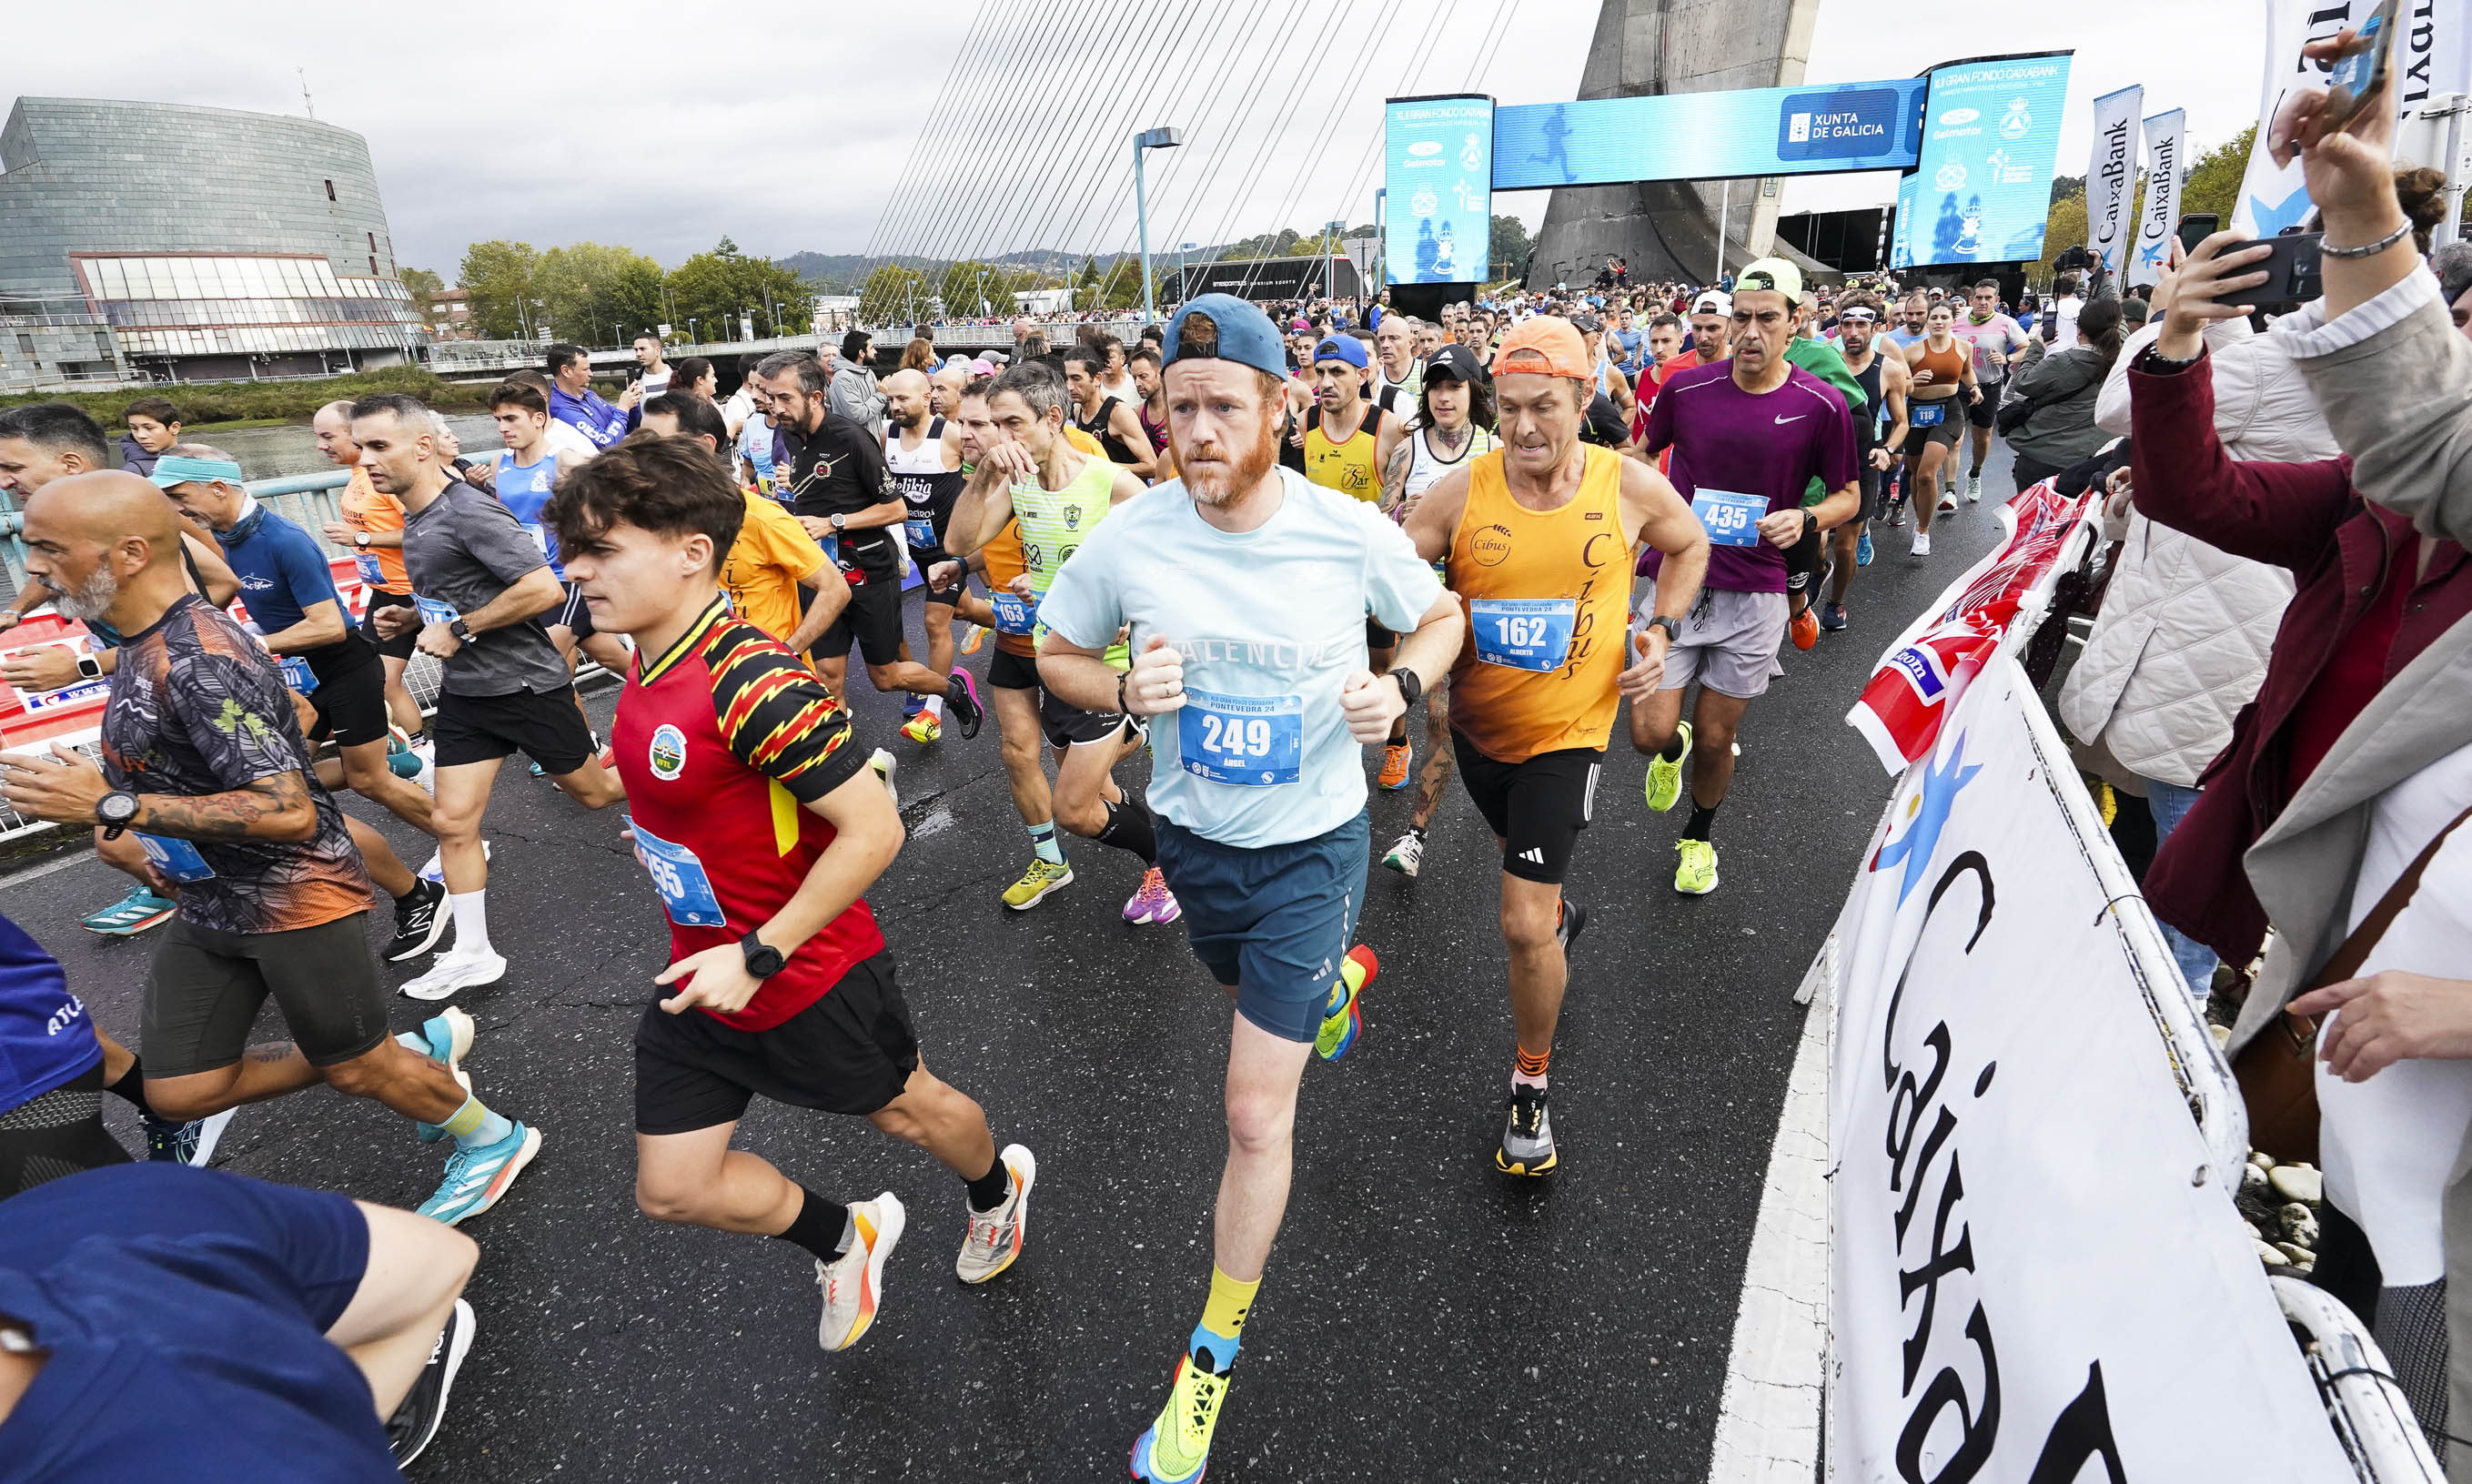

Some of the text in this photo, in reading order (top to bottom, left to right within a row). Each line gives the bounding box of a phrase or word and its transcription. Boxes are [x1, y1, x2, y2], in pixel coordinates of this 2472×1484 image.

[1814, 113, 1858, 126] XUNTA
[1812, 124, 1884, 138] DE GALICIA
[2099, 117, 2127, 243] CaixaBank
[2145, 136, 2174, 238] CaixaBank
[1704, 504, 1748, 530] 435
[1474, 539, 1507, 551] Cibus
[1000, 603, 1025, 622] 163
[1495, 617, 1547, 647] 162
[1210, 702, 1262, 713] PONTEVEDRA
[1202, 714, 1271, 757] 249
[1223, 757, 1246, 768] ÁNGEL
